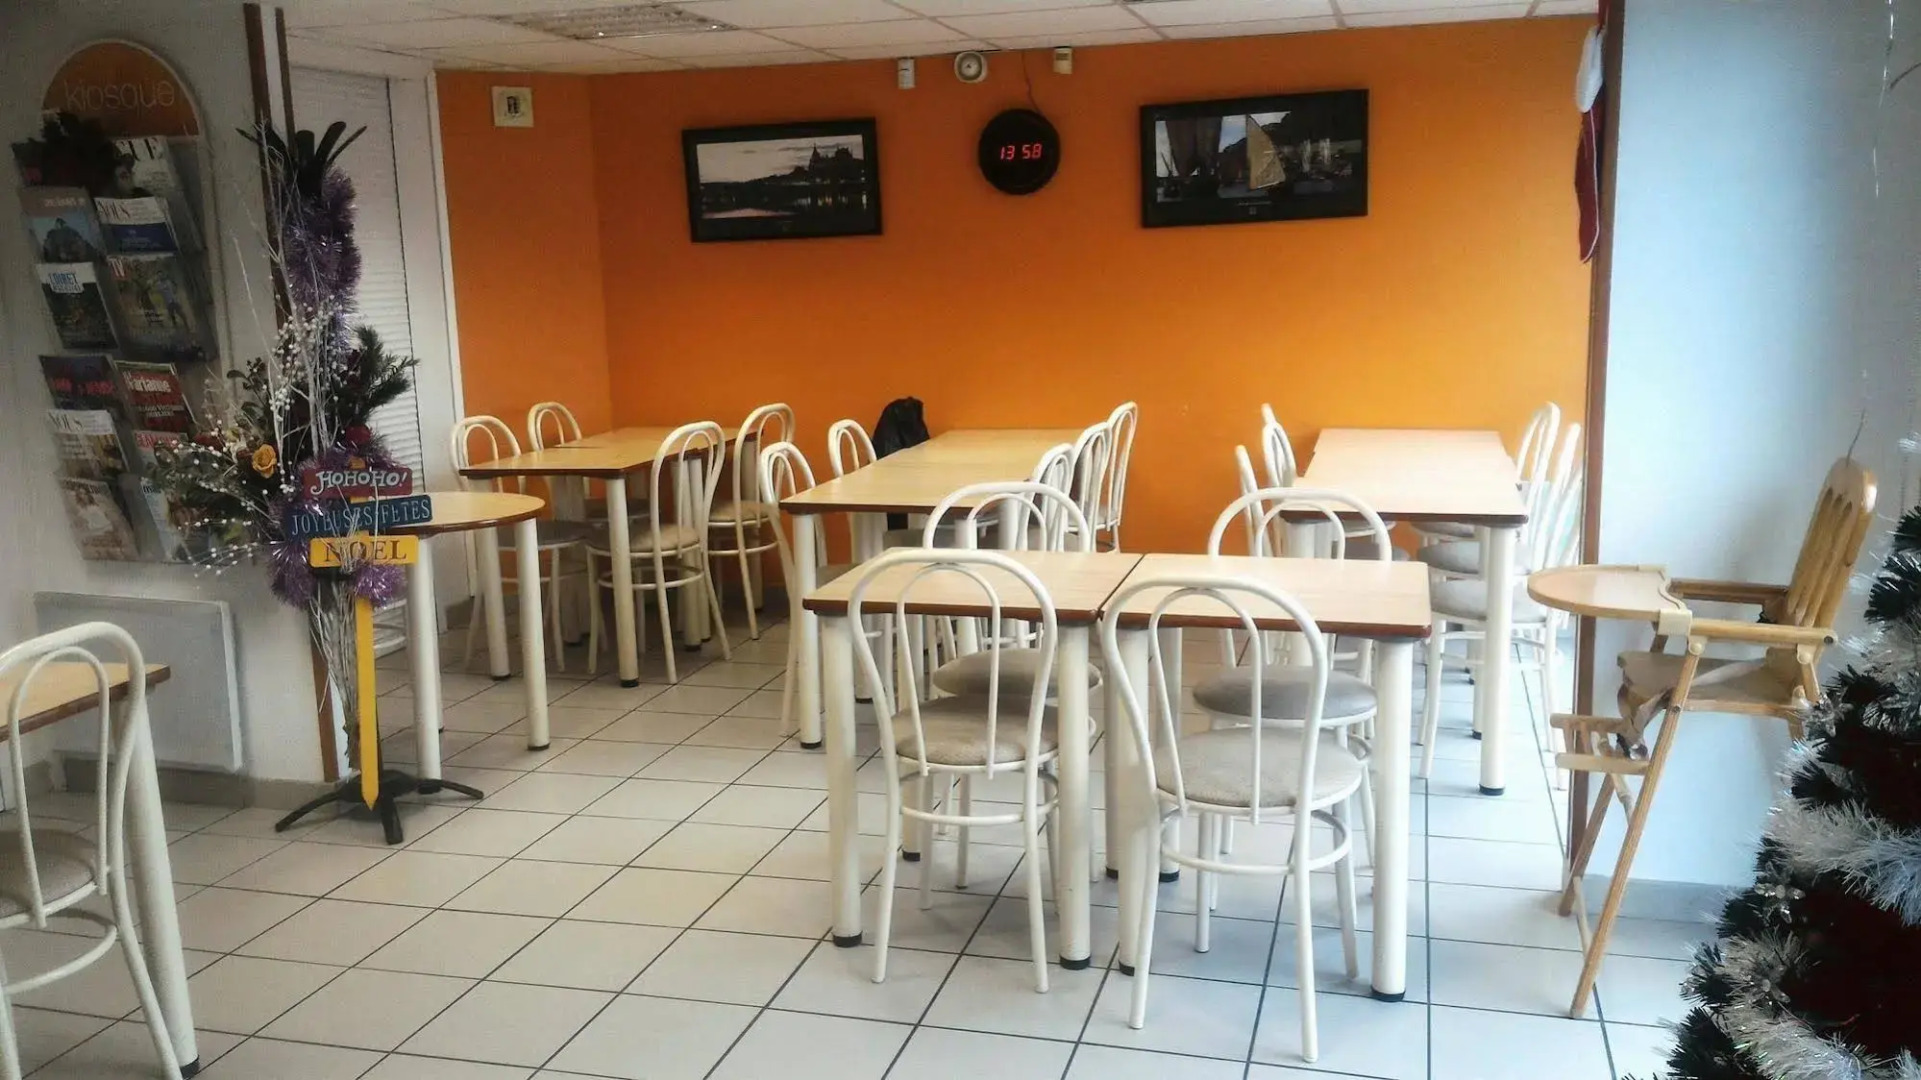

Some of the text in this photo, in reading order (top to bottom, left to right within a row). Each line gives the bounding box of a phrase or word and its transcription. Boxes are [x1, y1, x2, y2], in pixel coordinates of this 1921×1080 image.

[64, 79, 175, 117] kiosque
[1000, 143, 1042, 160] 13 58
